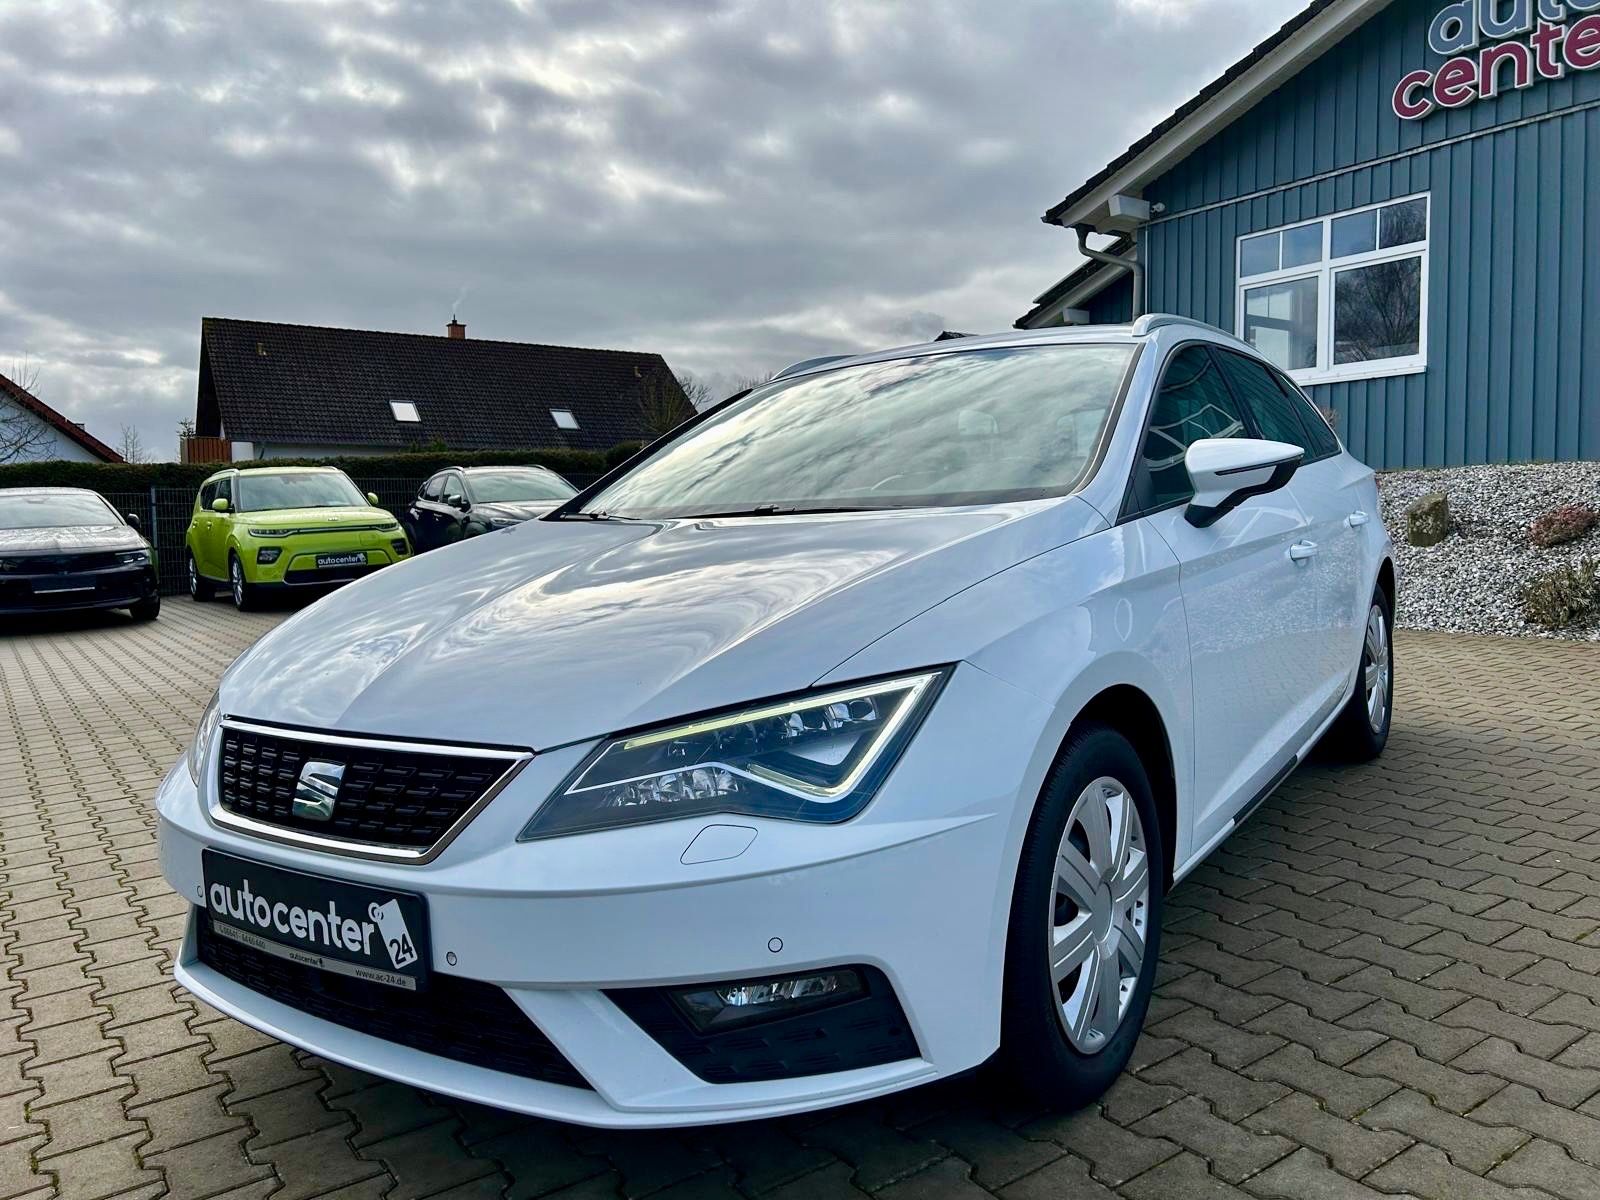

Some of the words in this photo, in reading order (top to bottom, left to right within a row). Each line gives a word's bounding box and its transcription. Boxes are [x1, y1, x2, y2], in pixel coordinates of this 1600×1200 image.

[1428, 0, 1600, 55] au
[318, 555, 358, 565] autocenter
[209, 879, 375, 955] autocenter
[388, 933, 414, 965] 24
[355, 969, 407, 986] www.ac-24.de
